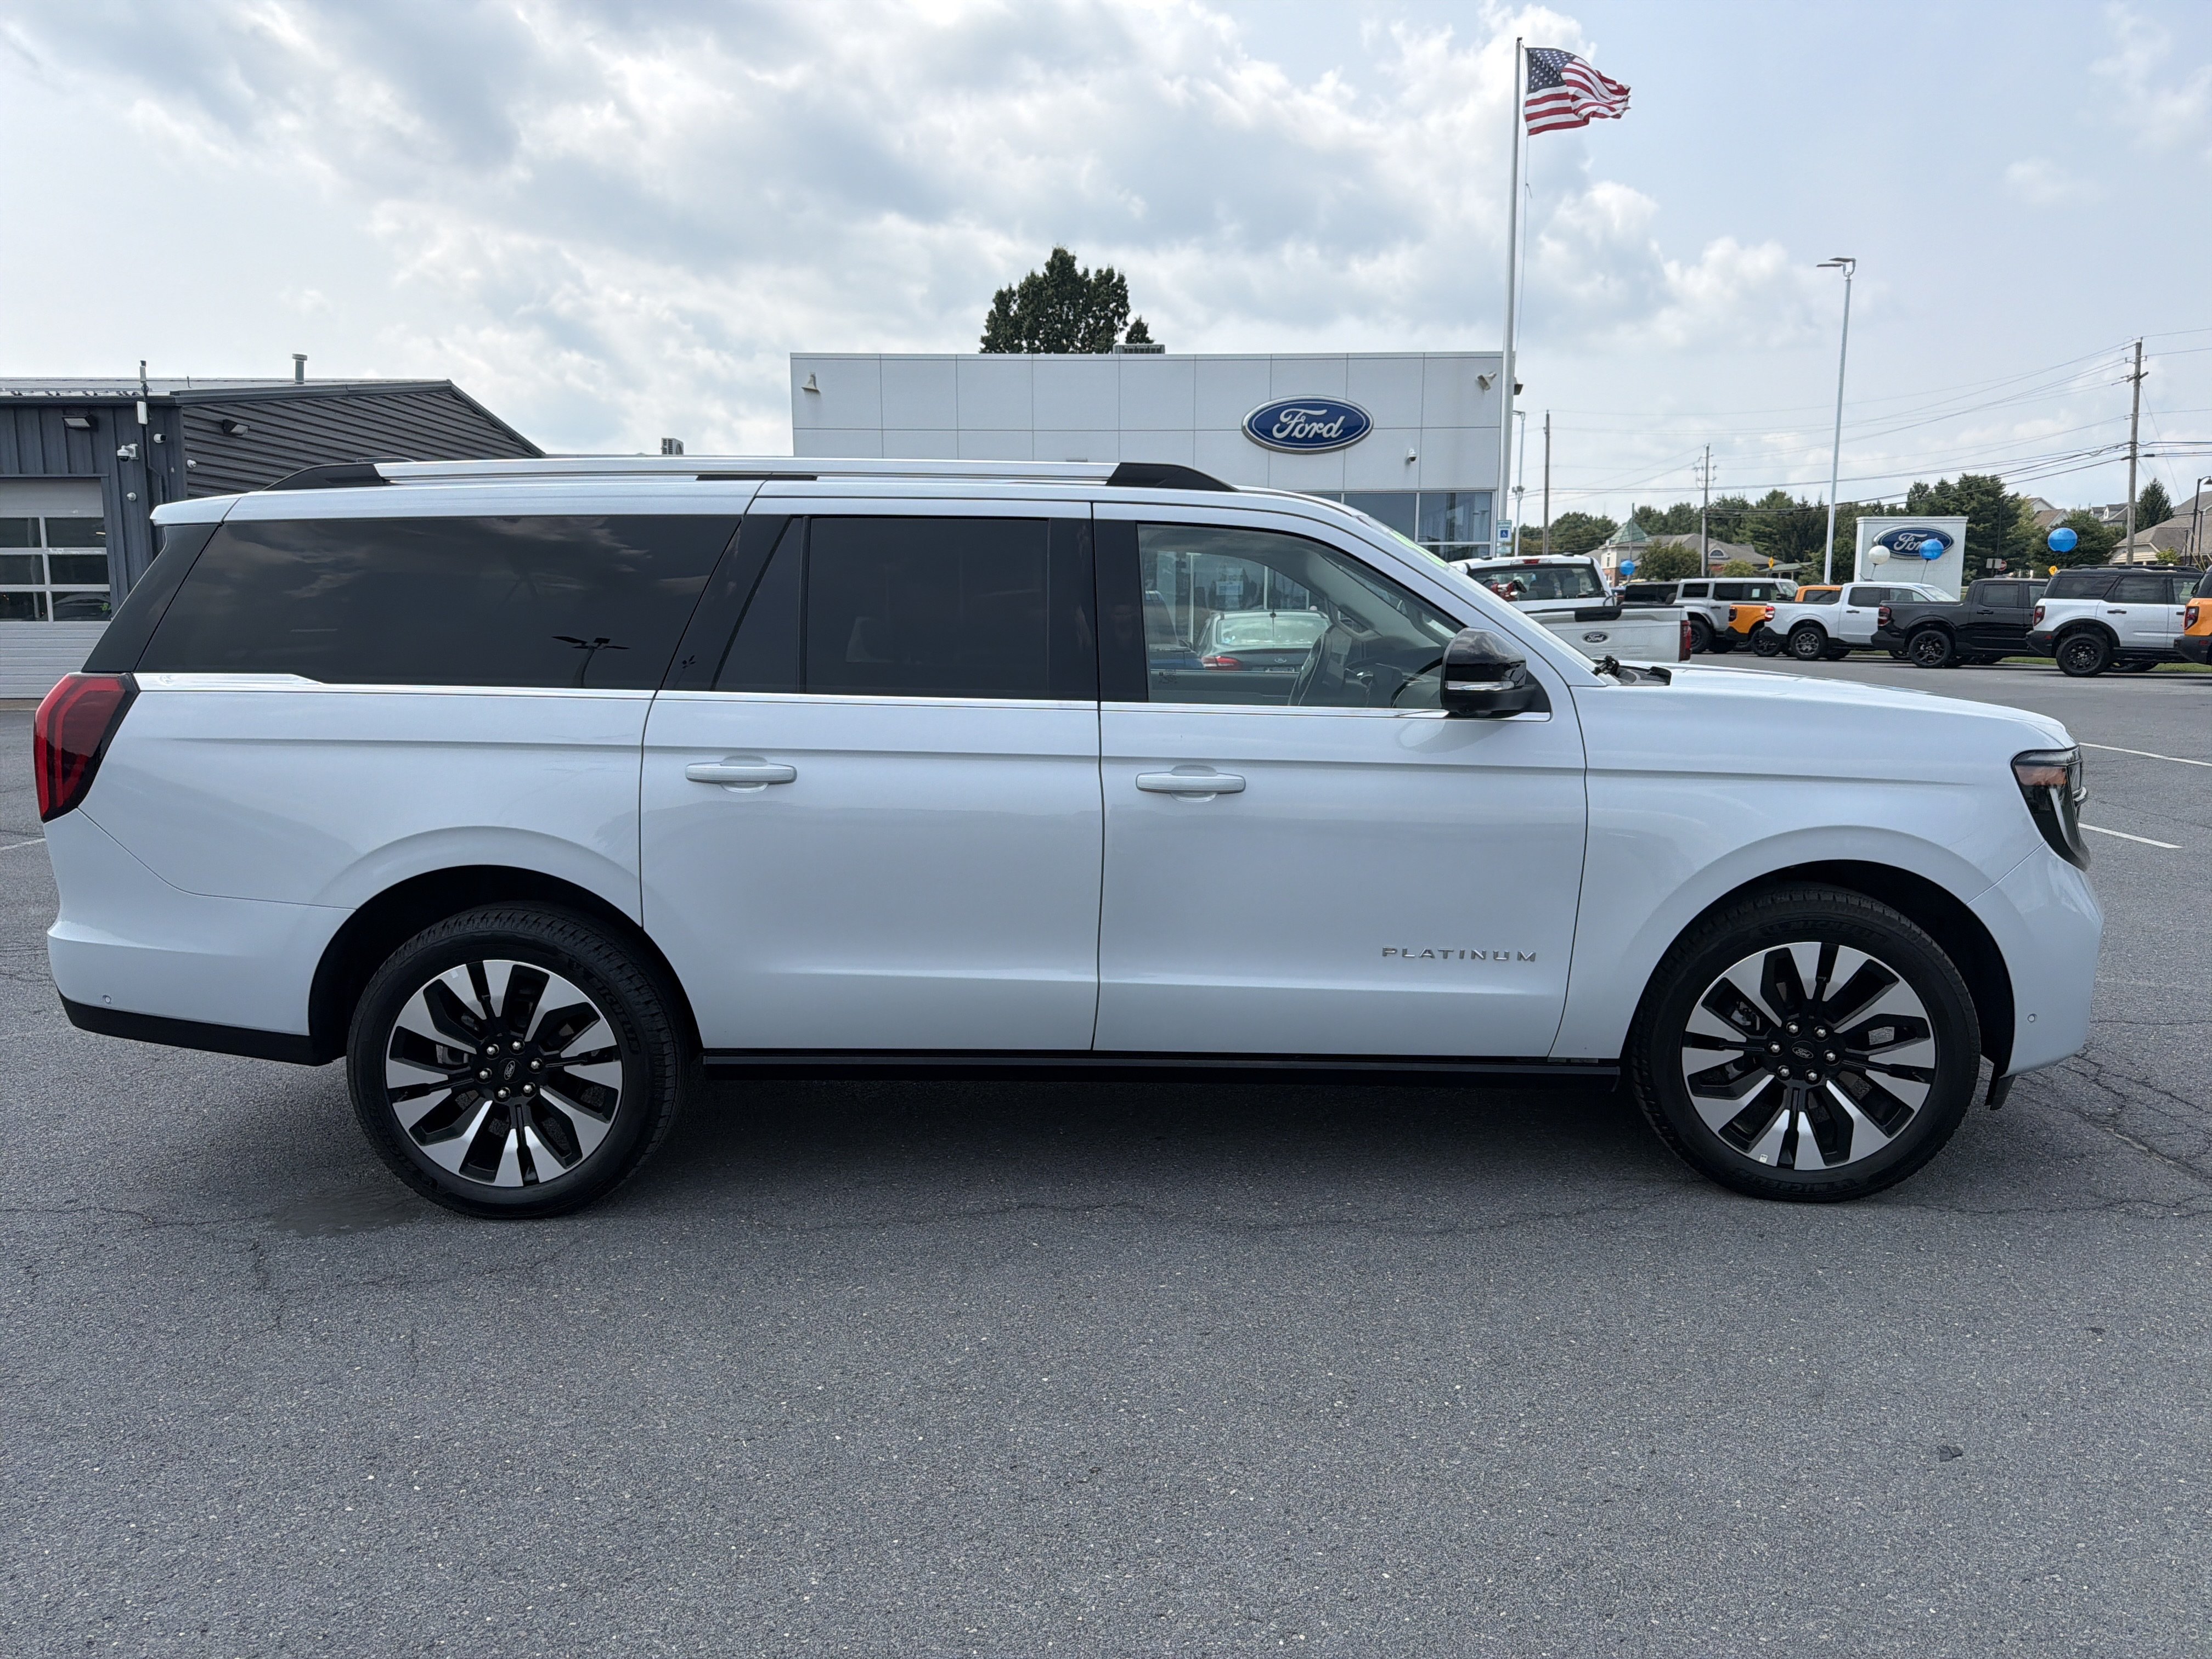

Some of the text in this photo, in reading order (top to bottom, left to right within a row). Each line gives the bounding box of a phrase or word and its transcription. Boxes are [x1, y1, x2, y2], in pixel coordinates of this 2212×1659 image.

[1272, 408, 1345, 439] Ford
[1893, 532, 1939, 551] For
[1381, 946, 1536, 962] PLATINUM
